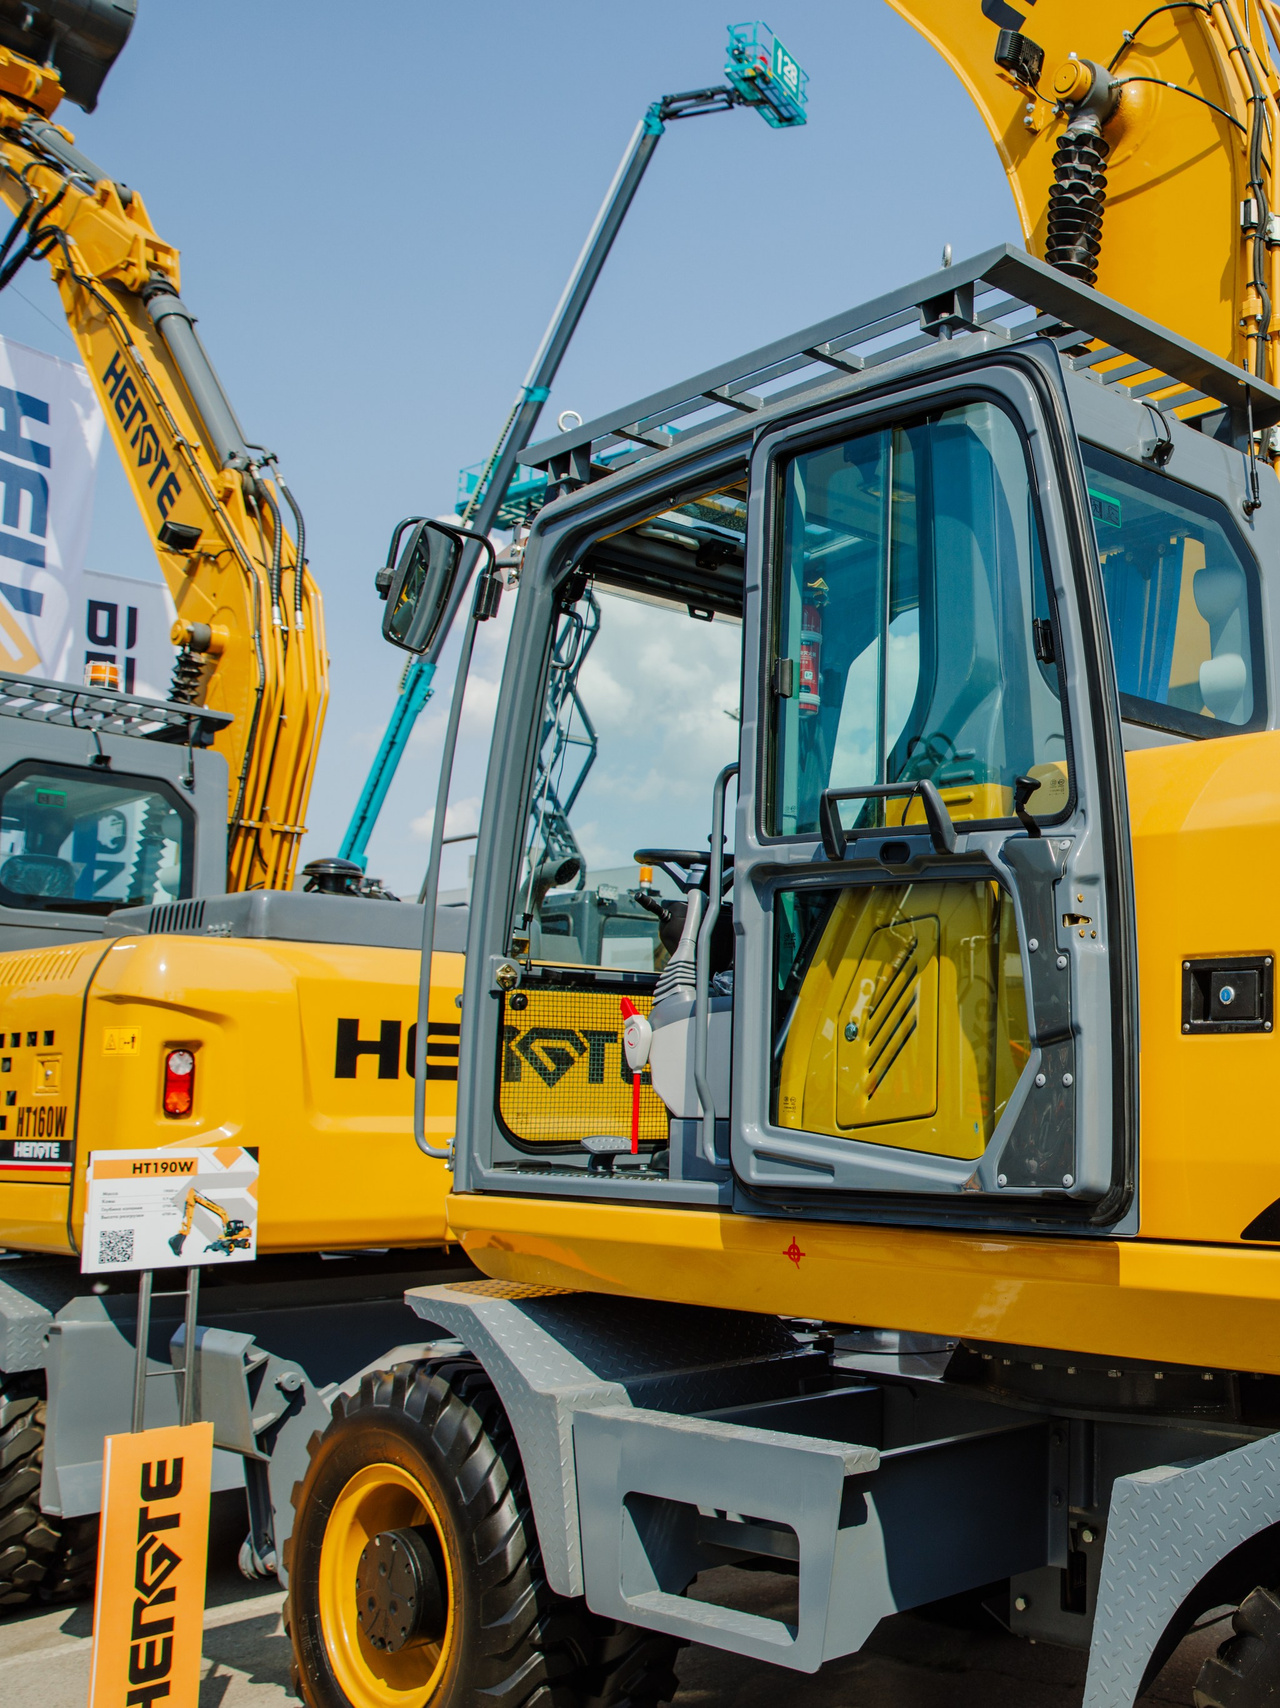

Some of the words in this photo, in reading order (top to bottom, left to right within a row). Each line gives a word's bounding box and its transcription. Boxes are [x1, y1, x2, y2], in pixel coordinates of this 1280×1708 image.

[102, 350, 182, 520] HENGTE
[16, 1106, 67, 1137] HT160W
[132, 1161, 194, 1175] HT190W
